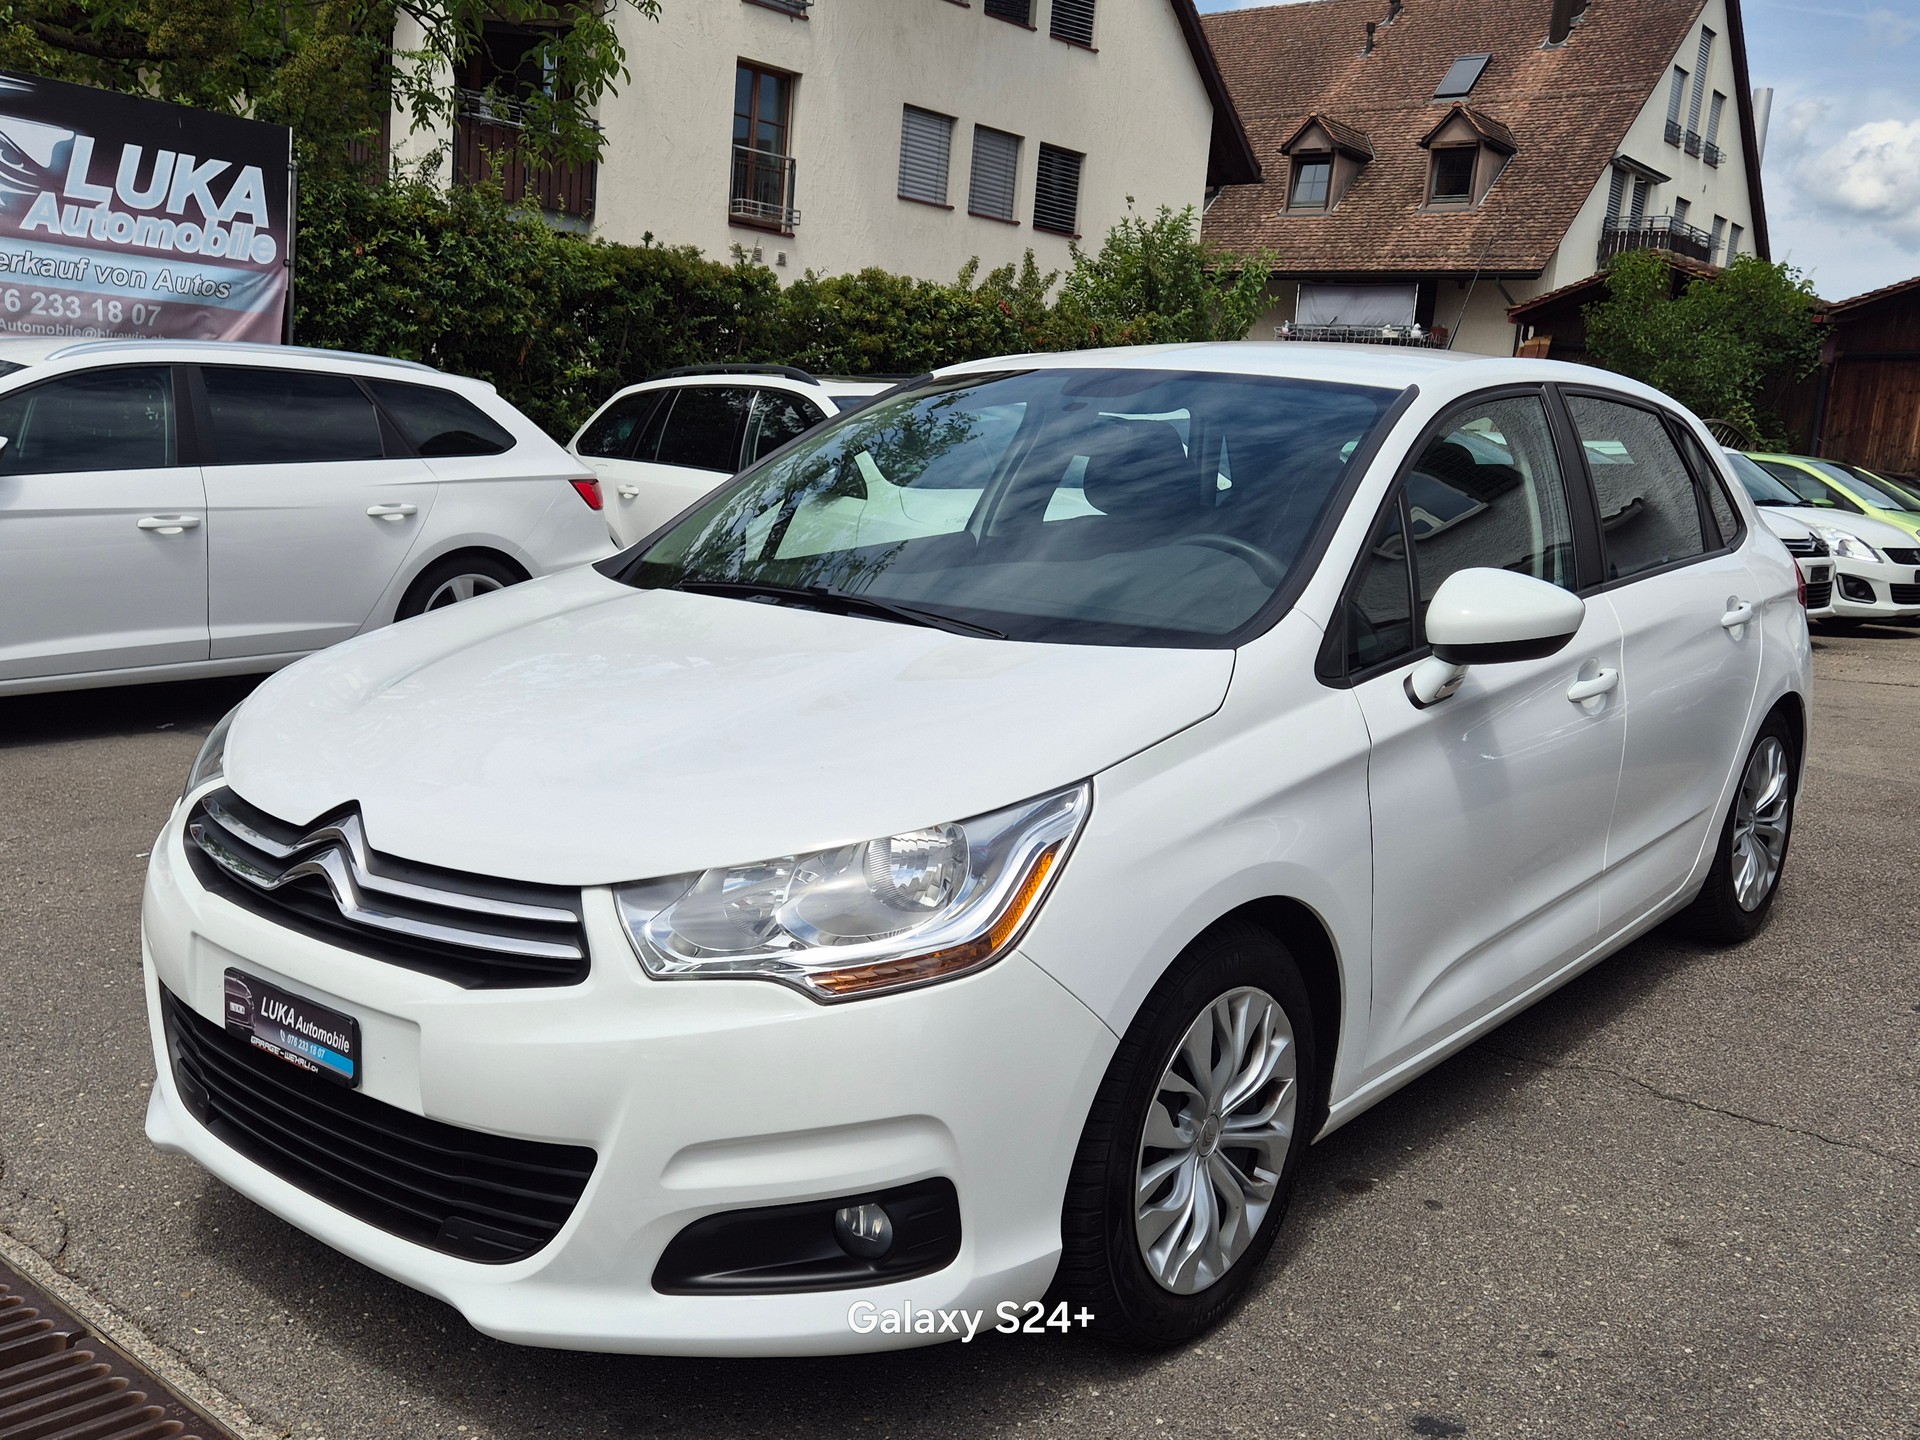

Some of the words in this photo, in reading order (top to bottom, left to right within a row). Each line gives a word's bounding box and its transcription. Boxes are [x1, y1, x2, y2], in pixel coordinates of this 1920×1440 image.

[63, 134, 270, 228] LUKA
[19, 191, 277, 264] Automobile
[94, 264, 147, 289] von
[152, 269, 232, 299] Autos
[0, 287, 21, 313] 6
[31, 291, 81, 319] 233
[91, 298, 123, 323] 18
[132, 303, 162, 326] 07
[260, 996, 295, 1029] LUKA
[295, 1016, 350, 1053] Automobile
[287, 1034, 298, 1047] 076
[298, 1039, 309, 1052] 233
[310, 1044, 317, 1056] 18
[317, 1048, 326, 1059] 07
